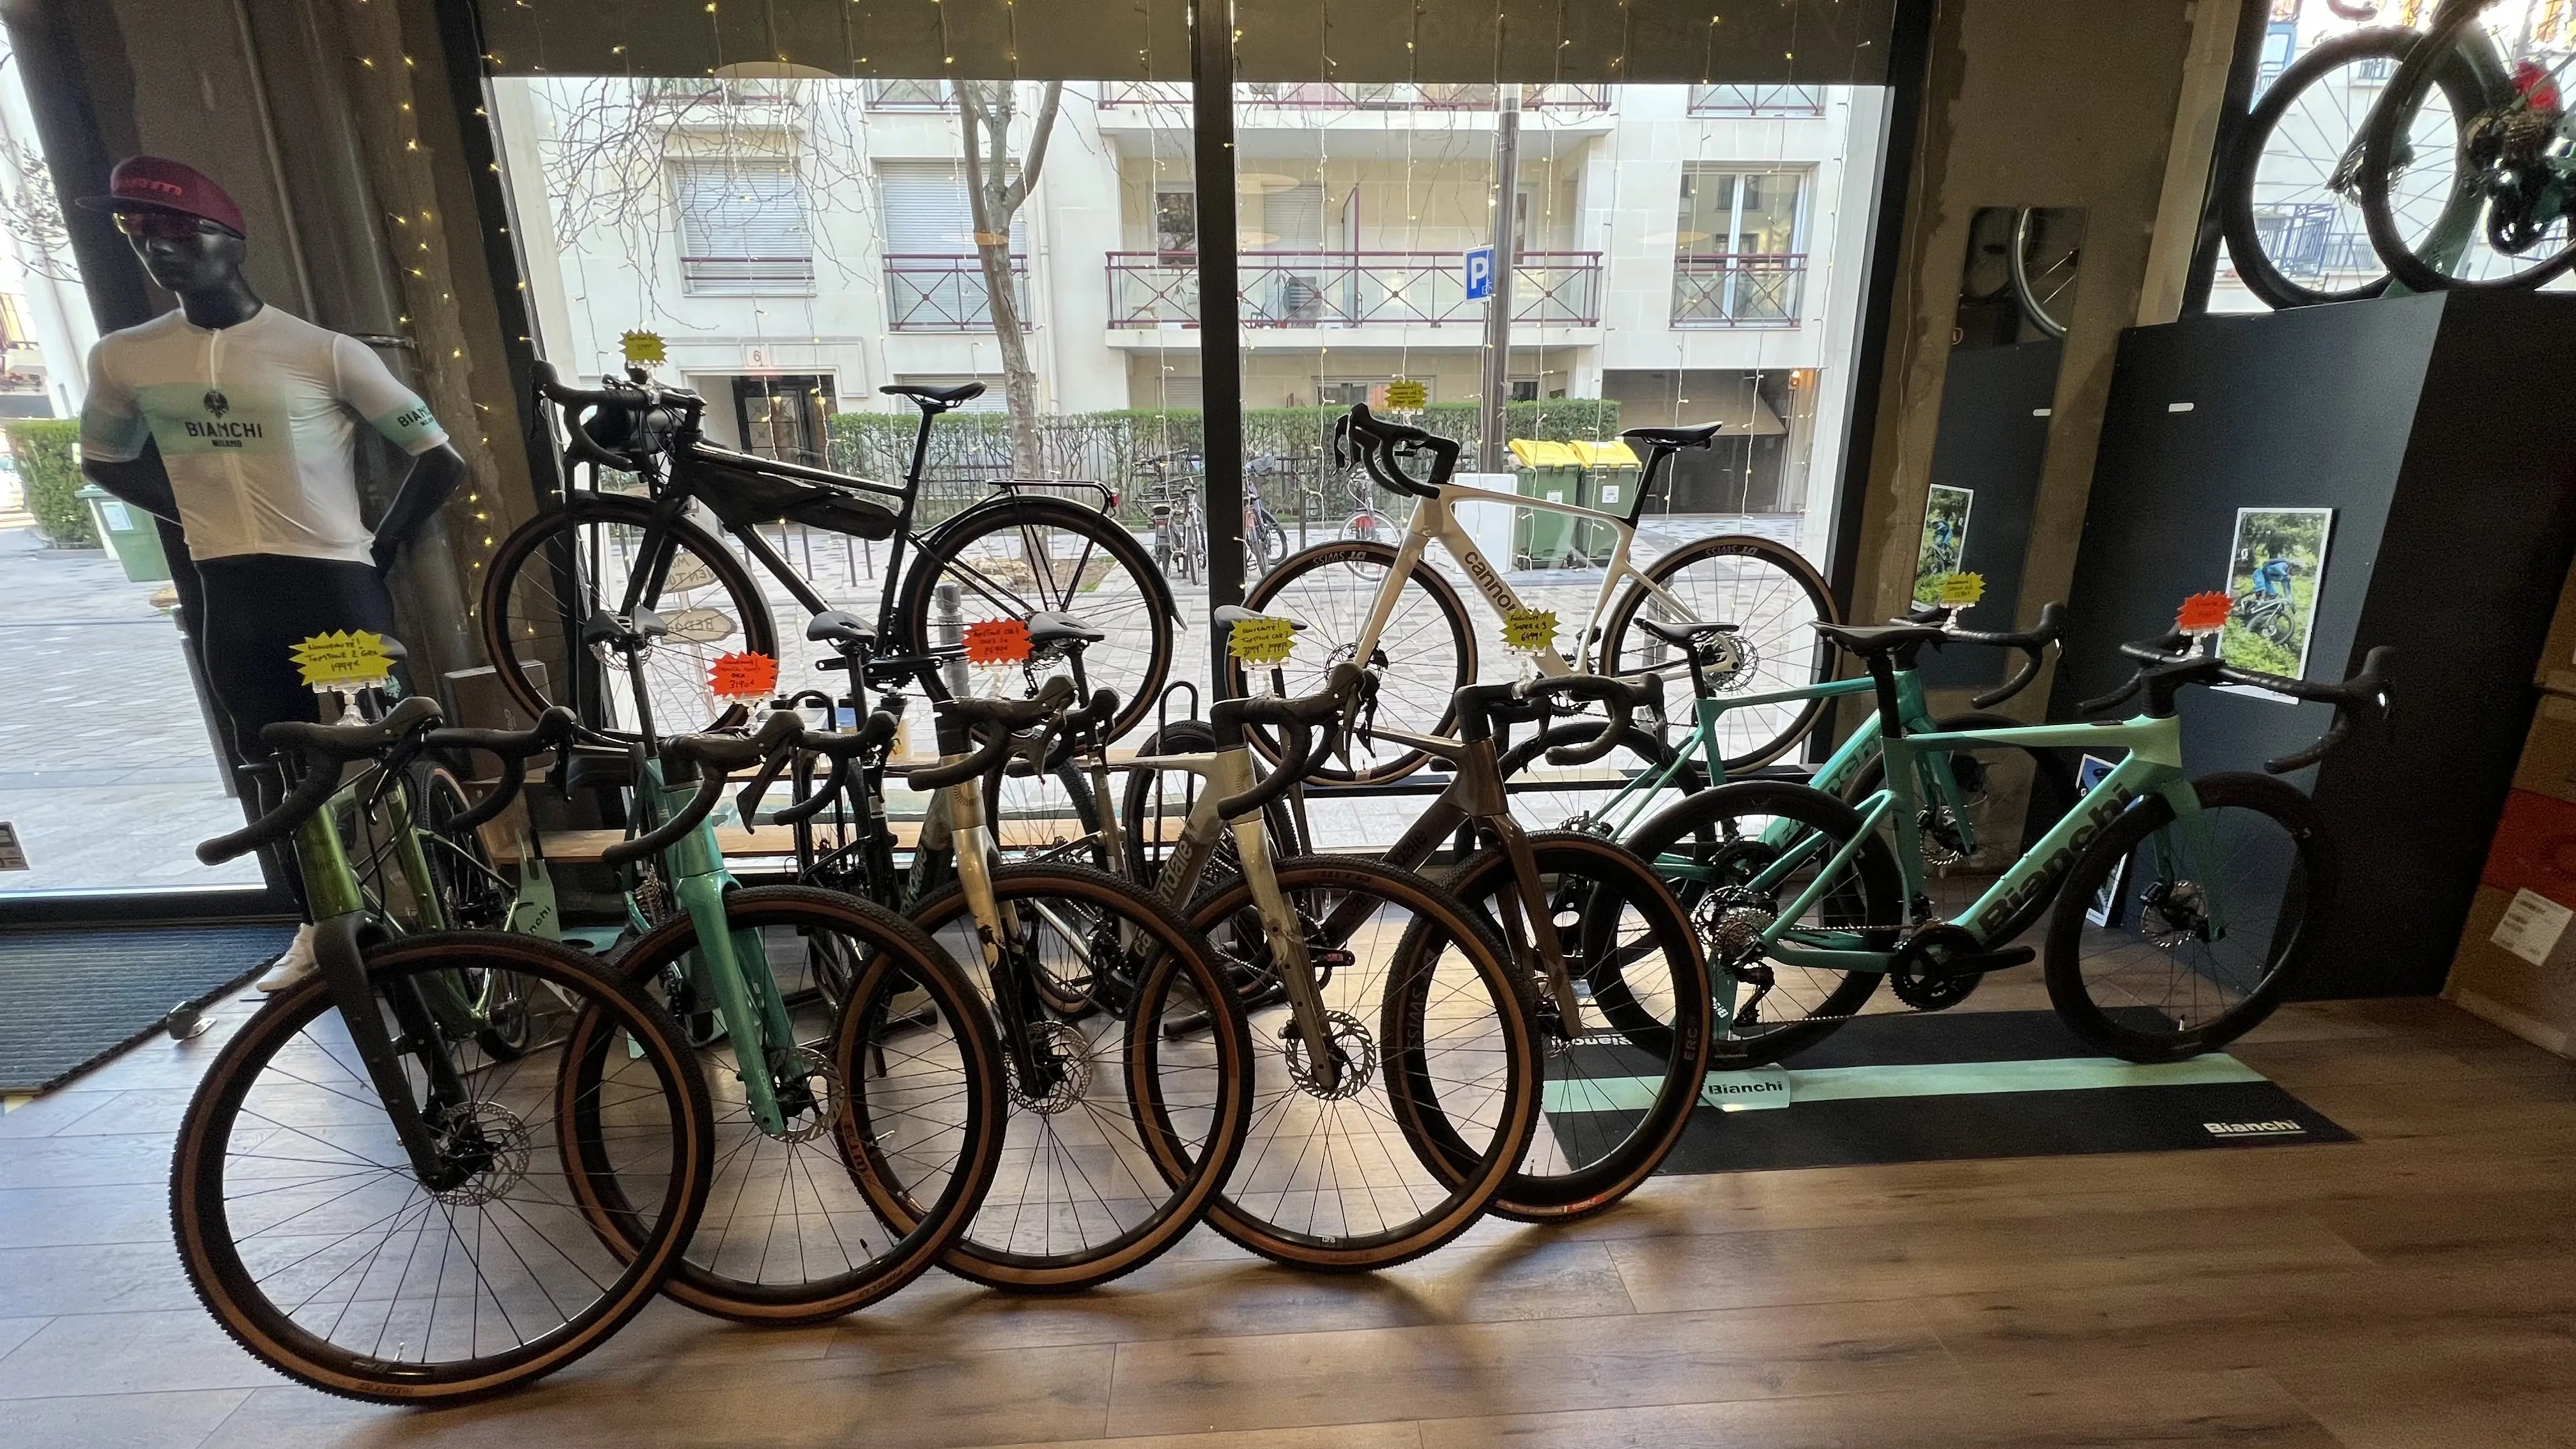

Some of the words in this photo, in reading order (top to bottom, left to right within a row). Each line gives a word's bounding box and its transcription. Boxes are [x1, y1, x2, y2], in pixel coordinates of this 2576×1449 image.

[1471, 257, 1489, 289] P
[753, 349, 761, 362] 6
[185, 422, 263, 438] BIANCHI
[1312, 551, 1345, 567] SWISS
[1705, 546, 1738, 558] SWISS
[1977, 782, 2120, 938] Bianchi
[528, 905, 551, 935] nchi
[1708, 1081, 1783, 1095] Bianchi
[2203, 1119, 2302, 1133] Bianchi
